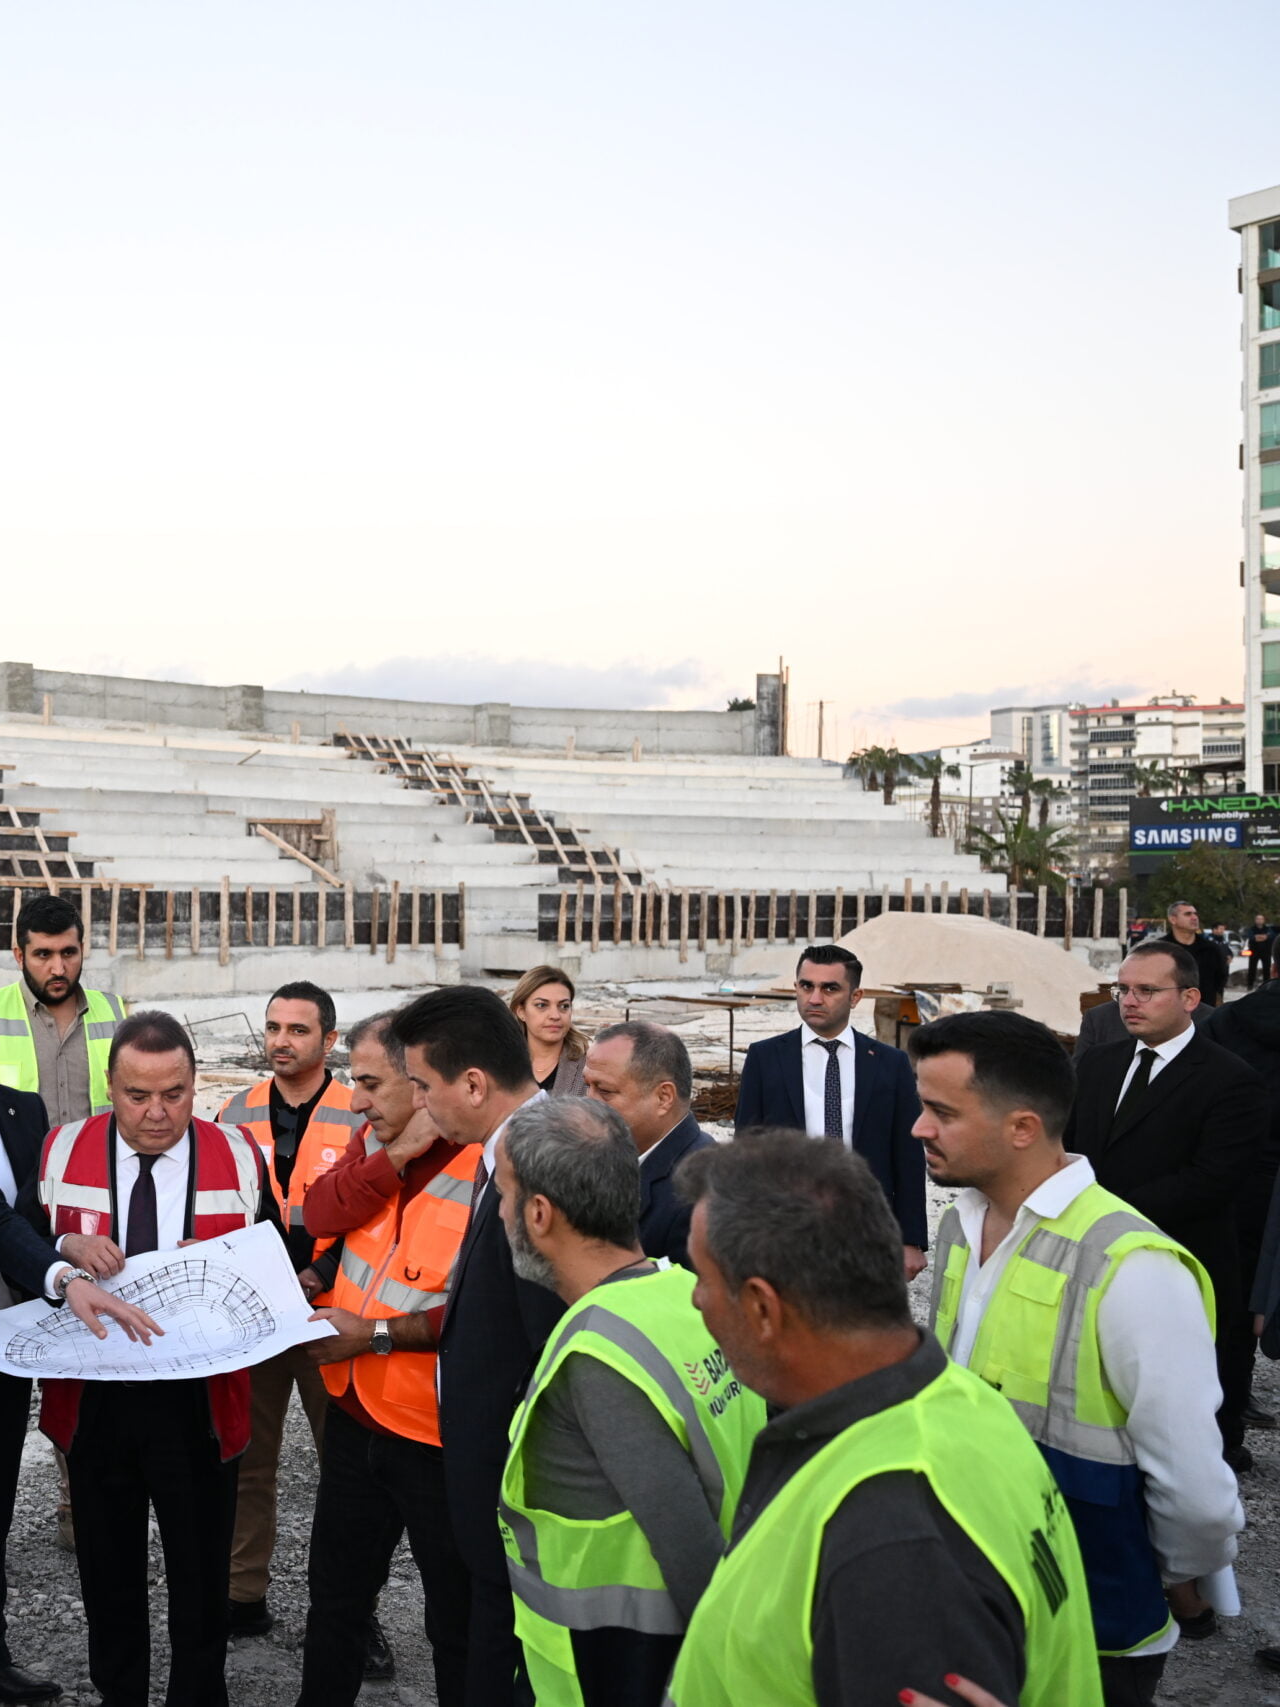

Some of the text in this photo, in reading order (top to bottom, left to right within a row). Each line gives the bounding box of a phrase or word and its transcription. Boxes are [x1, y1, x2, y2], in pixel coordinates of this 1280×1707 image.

[1168, 796, 1280, 812] HANEDA
[1211, 811, 1250, 820] mobilya
[1134, 826, 1237, 846] SAMSUNG
